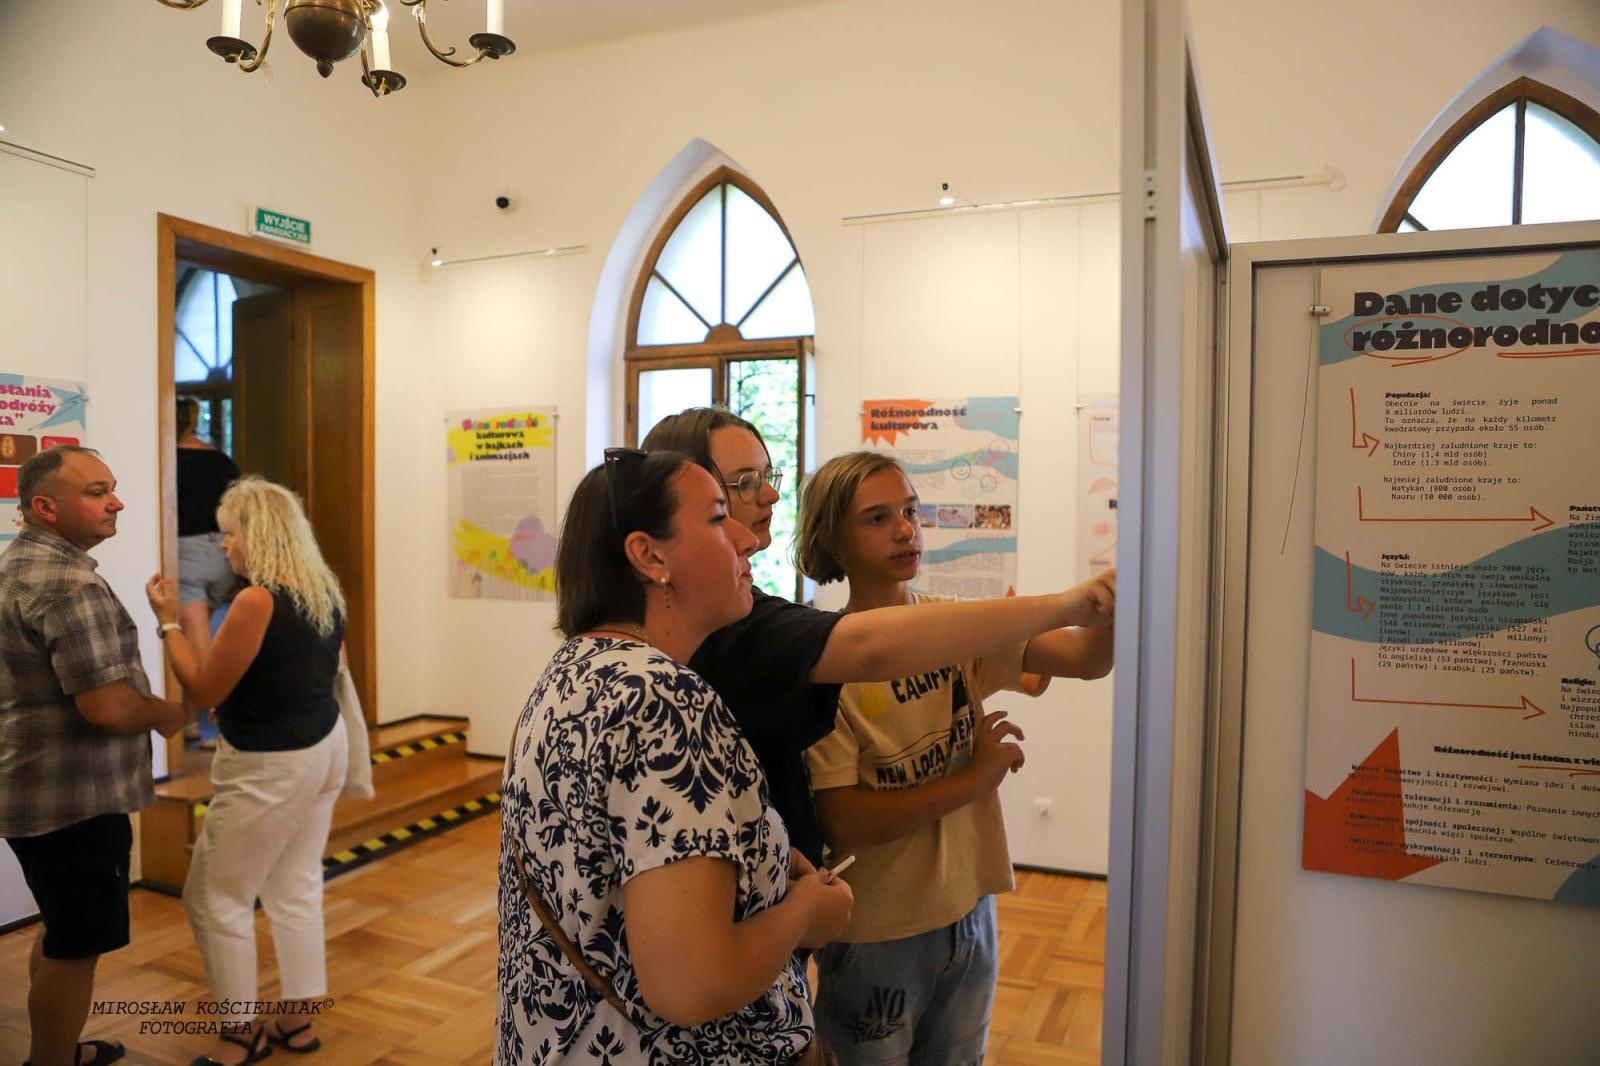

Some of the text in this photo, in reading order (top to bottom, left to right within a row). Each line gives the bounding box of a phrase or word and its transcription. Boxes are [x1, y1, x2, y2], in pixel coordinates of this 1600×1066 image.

[263, 213, 305, 233] WYJŚCIE
[1354, 282, 1600, 317] Dane dotyc
[1353, 319, 1600, 351] różnorodno
[0, 384, 52, 399] stania
[1499, 398, 1520, 407] żyje
[1531, 398, 1558, 406] ponad
[0, 400, 56, 416] odróży
[870, 405, 967, 418] Różnorodność
[1483, 416, 1508, 424] każdy
[870, 421, 939, 431] kulturowa
[1436, 425, 1475, 433] przypada
[476, 431, 525, 439] kulturowa
[485, 440, 524, 451] bajkach
[1384, 442, 1435, 450] Najbardziej
[1493, 442, 1518, 450] kraje
[474, 450, 530, 462] animacjach
[1463, 459, 1491, 467] osób).
[1452, 485, 1476, 493] osób)
[1432, 563, 1469, 571] istnieje
[1508, 634, 1547, 643] miliony)
[1463, 649, 1511, 658] większości
[1391, 653, 1432, 661] angielski
[1502, 659, 1546, 668] francuski
[1396, 662, 1428, 670] państw)
[1561, 685, 1571, 693] Na
[1570, 721, 1595, 729] islam
[1434, 744, 1509, 758] Różnorodność
[1510, 752, 1531, 760] jest
[1532, 753, 1571, 764] istotna
[876, 762, 908, 784] NEW
[1436, 771, 1498, 783] kreatywności:
[1503, 777, 1539, 787] Wymiana
[1545, 780, 1564, 788] idei
[1405, 793, 1451, 804] tolerancji
[1463, 800, 1522, 810] zrozumienia:
[1526, 805, 1568, 815] Poznanie
[1405, 818, 1447, 828] spójności
[1511, 828, 1547, 839] Wspólne
[1441, 830, 1464, 839] więzi
[865, 986, 906, 1020] NO
